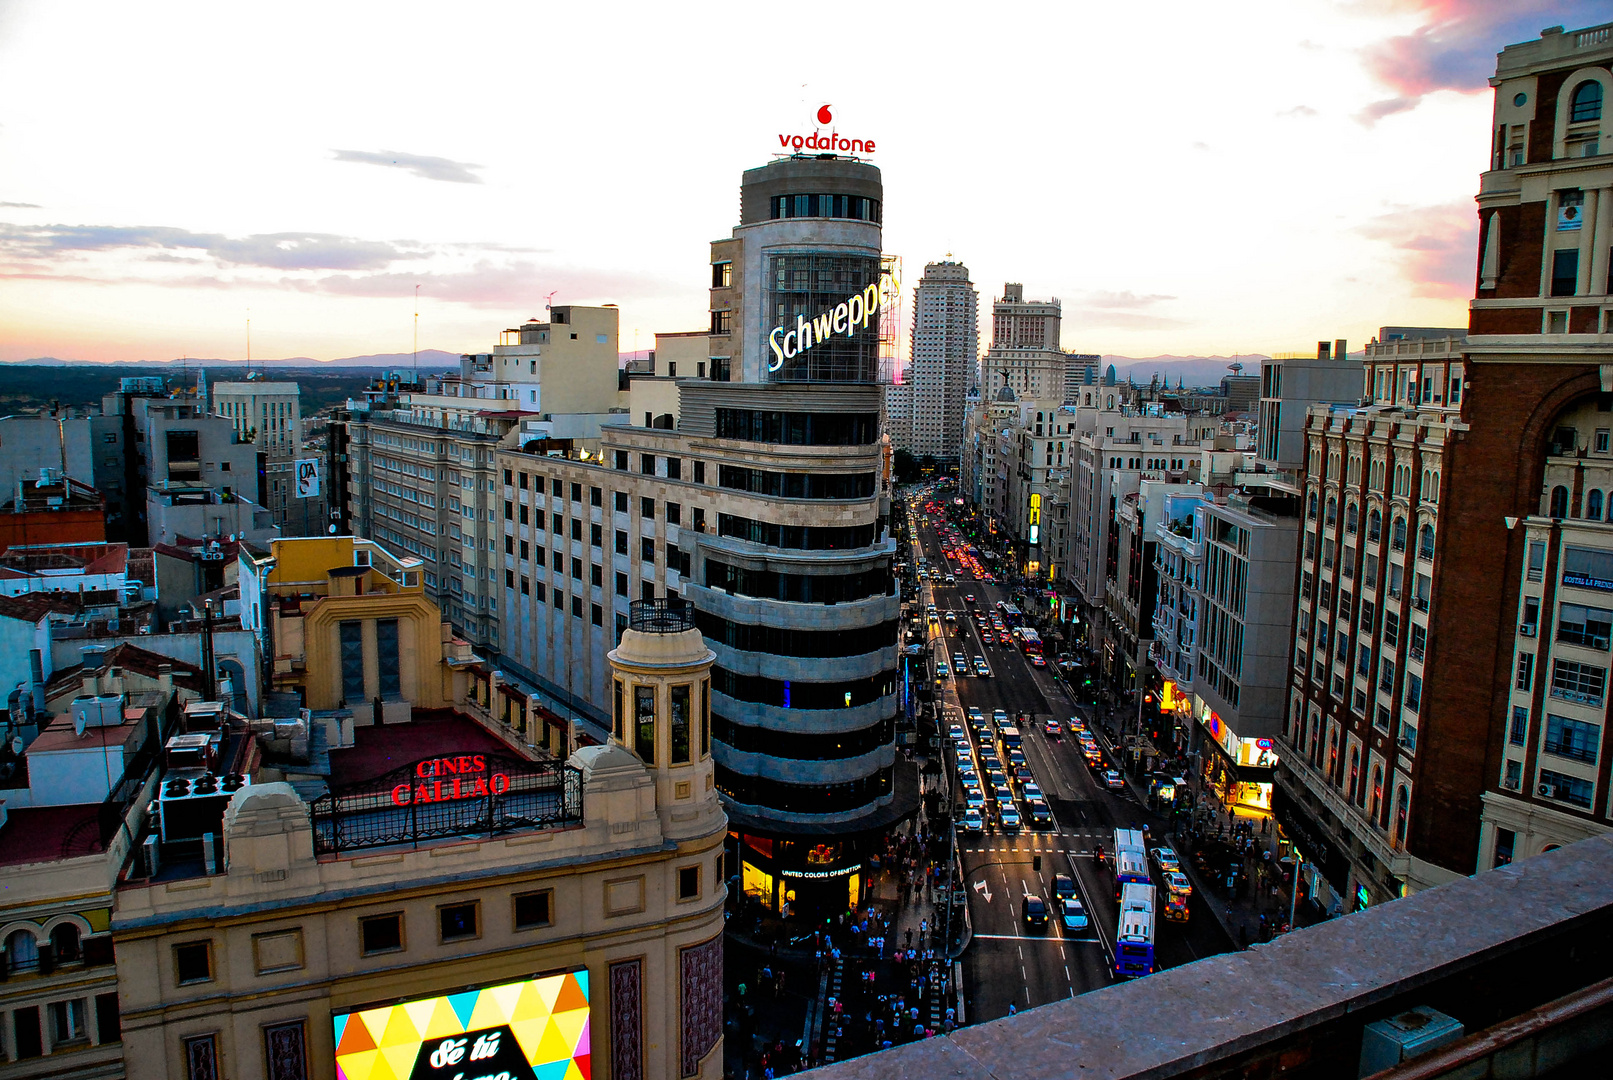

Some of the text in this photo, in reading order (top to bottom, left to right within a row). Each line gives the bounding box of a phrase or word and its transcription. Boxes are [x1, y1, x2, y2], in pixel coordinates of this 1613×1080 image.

[779, 132, 876, 153] vodafone
[768, 270, 902, 372] Schweppes
[416, 755, 486, 779] CINES
[391, 773, 510, 806] CALLAO
[781, 870, 803, 878] UNITED
[804, 871, 829, 879] COLORS
[837, 864, 862, 876] BENETTON
[430, 1031, 502, 1069] Sé tú
